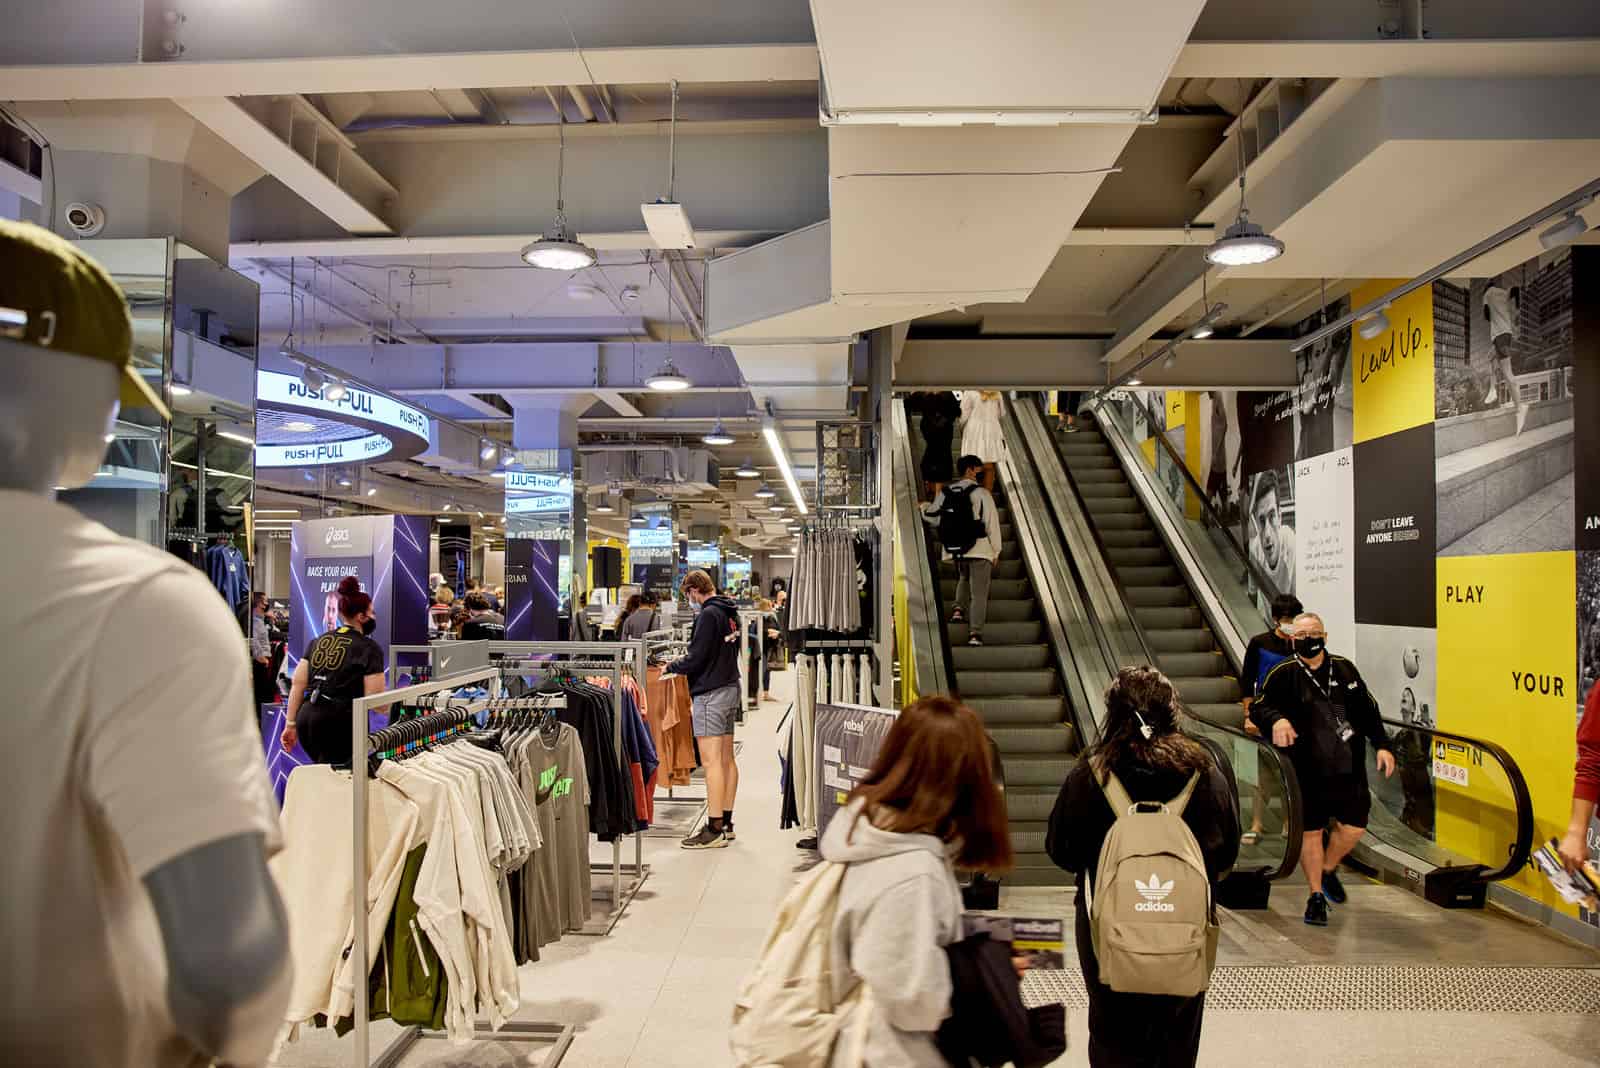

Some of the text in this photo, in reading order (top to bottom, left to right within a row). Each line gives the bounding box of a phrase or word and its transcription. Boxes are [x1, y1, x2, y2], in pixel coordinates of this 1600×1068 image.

[1361, 328, 1395, 383] Level
[285, 444, 344, 459] PUSH PULL
[1392, 516, 1415, 528] LEAVE
[323, 566, 340, 577] YOUR
[320, 582, 337, 593] PLAY
[1446, 585, 1484, 603] PLAY
[311, 634, 352, 671] 85
[1511, 671, 1564, 697] YOUR
[1135, 901, 1174, 912] adidas
